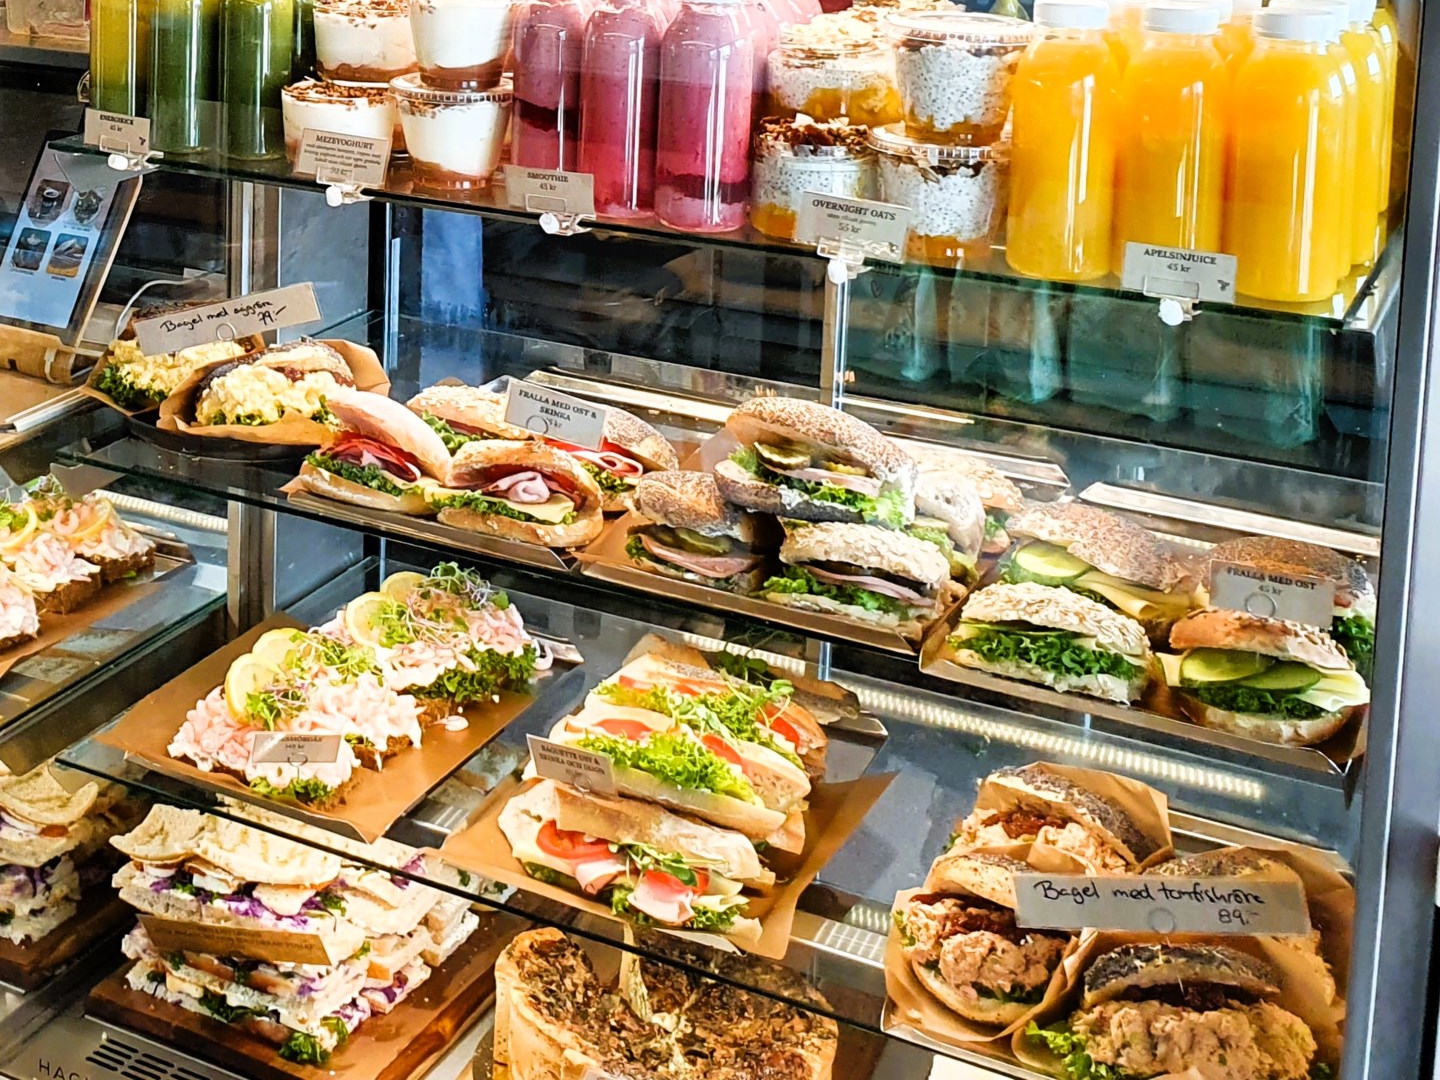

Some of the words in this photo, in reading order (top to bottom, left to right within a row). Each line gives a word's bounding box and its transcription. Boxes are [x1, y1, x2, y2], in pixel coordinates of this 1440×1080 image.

[316, 135, 374, 150] MEZEYOGHURT
[526, 171, 569, 183] SMOOTHIE
[812, 198, 863, 216] OVERNIGHT
[866, 207, 896, 220] OATS
[852, 224, 861, 233] kr
[1143, 248, 1217, 265] APELSINJUICE
[1180, 264, 1191, 274] kr
[160, 316, 203, 333] Bagel
[206, 307, 230, 319] med
[519, 389, 550, 405] FRALLA
[551, 399, 571, 410] MED
[573, 405, 590, 416] OST
[539, 406, 571, 421] SKINKA
[1227, 567, 1266, 581] FRALLA
[1268, 574, 1293, 586] MED
[1295, 580, 1316, 590] OST
[1272, 586, 1282, 595] kr
[1033, 880, 1100, 906] Bagel
[1112, 888, 1155, 901] med
